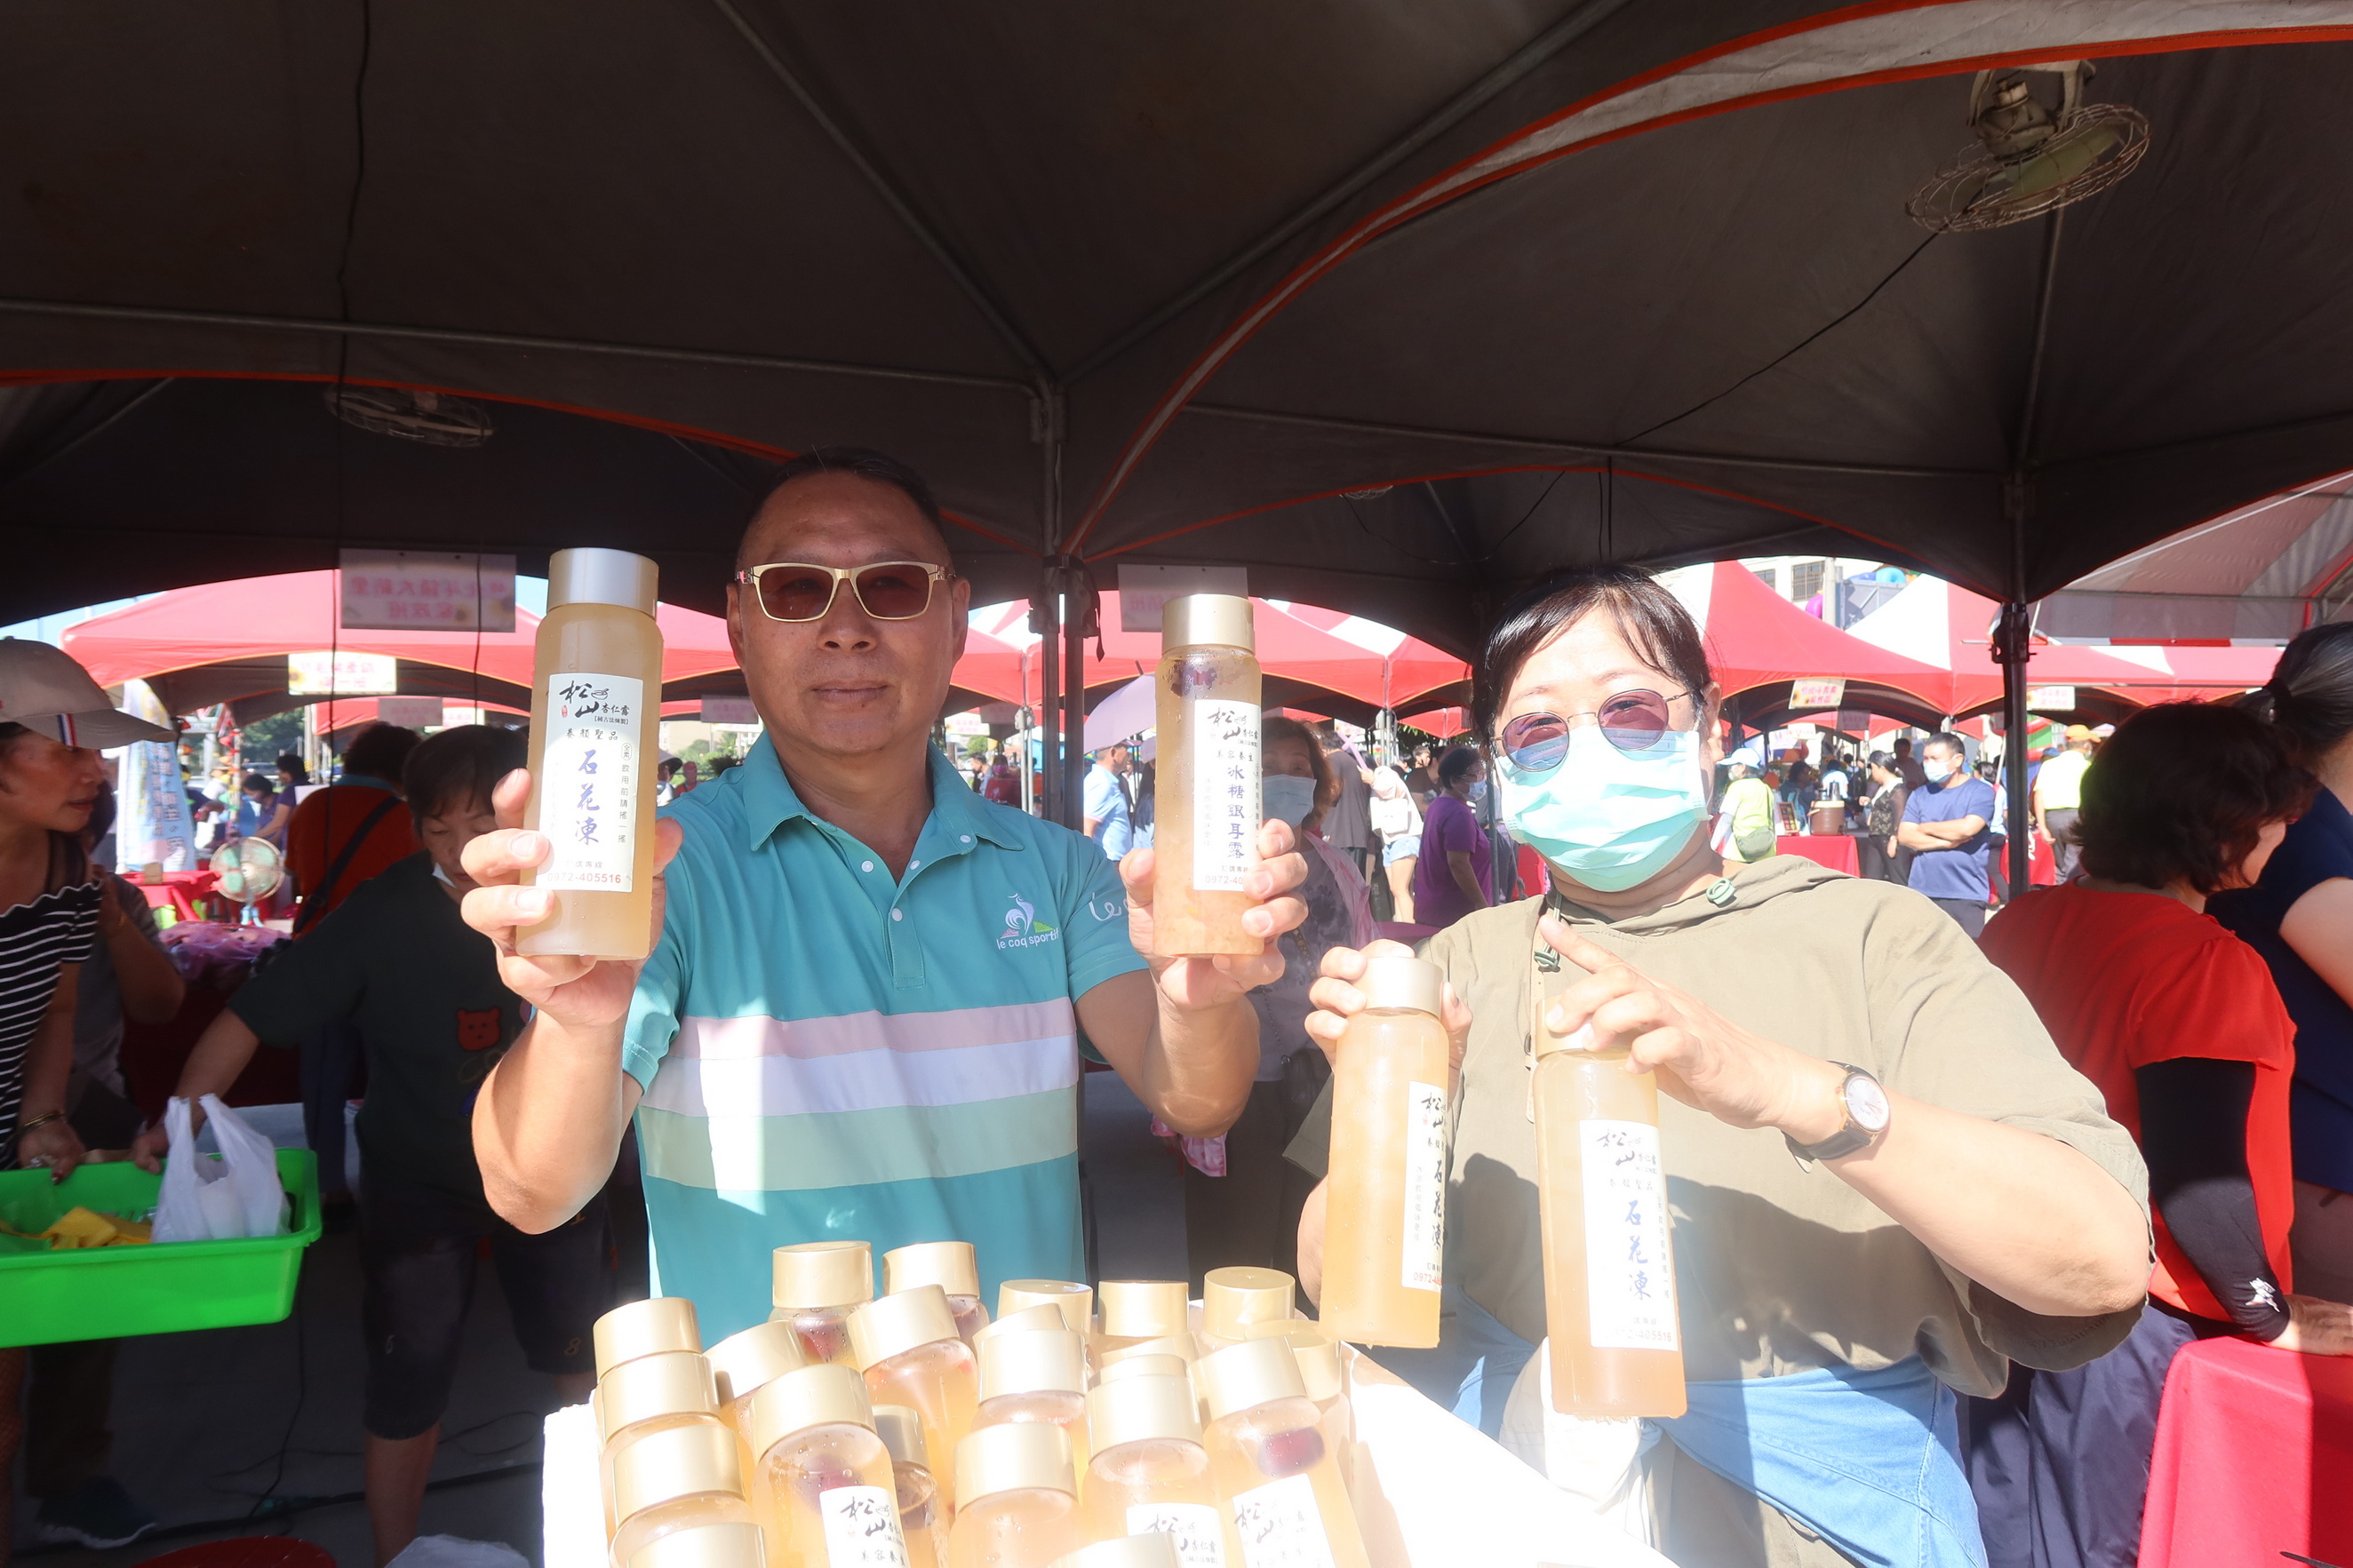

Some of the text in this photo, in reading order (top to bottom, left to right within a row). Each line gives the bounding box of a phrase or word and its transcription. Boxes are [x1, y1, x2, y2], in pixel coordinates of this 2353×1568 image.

[575, 749, 600, 846] 石花凍
[1226, 764, 1245, 859] 冰糖銀耳露
[547, 872, 621, 884] 0972-405516
[1205, 875, 1243, 885] 0972-40
[996, 938, 1006, 950] le
[1008, 936, 1028, 949] coq
[1624, 1199, 1651, 1301] 石花凍
